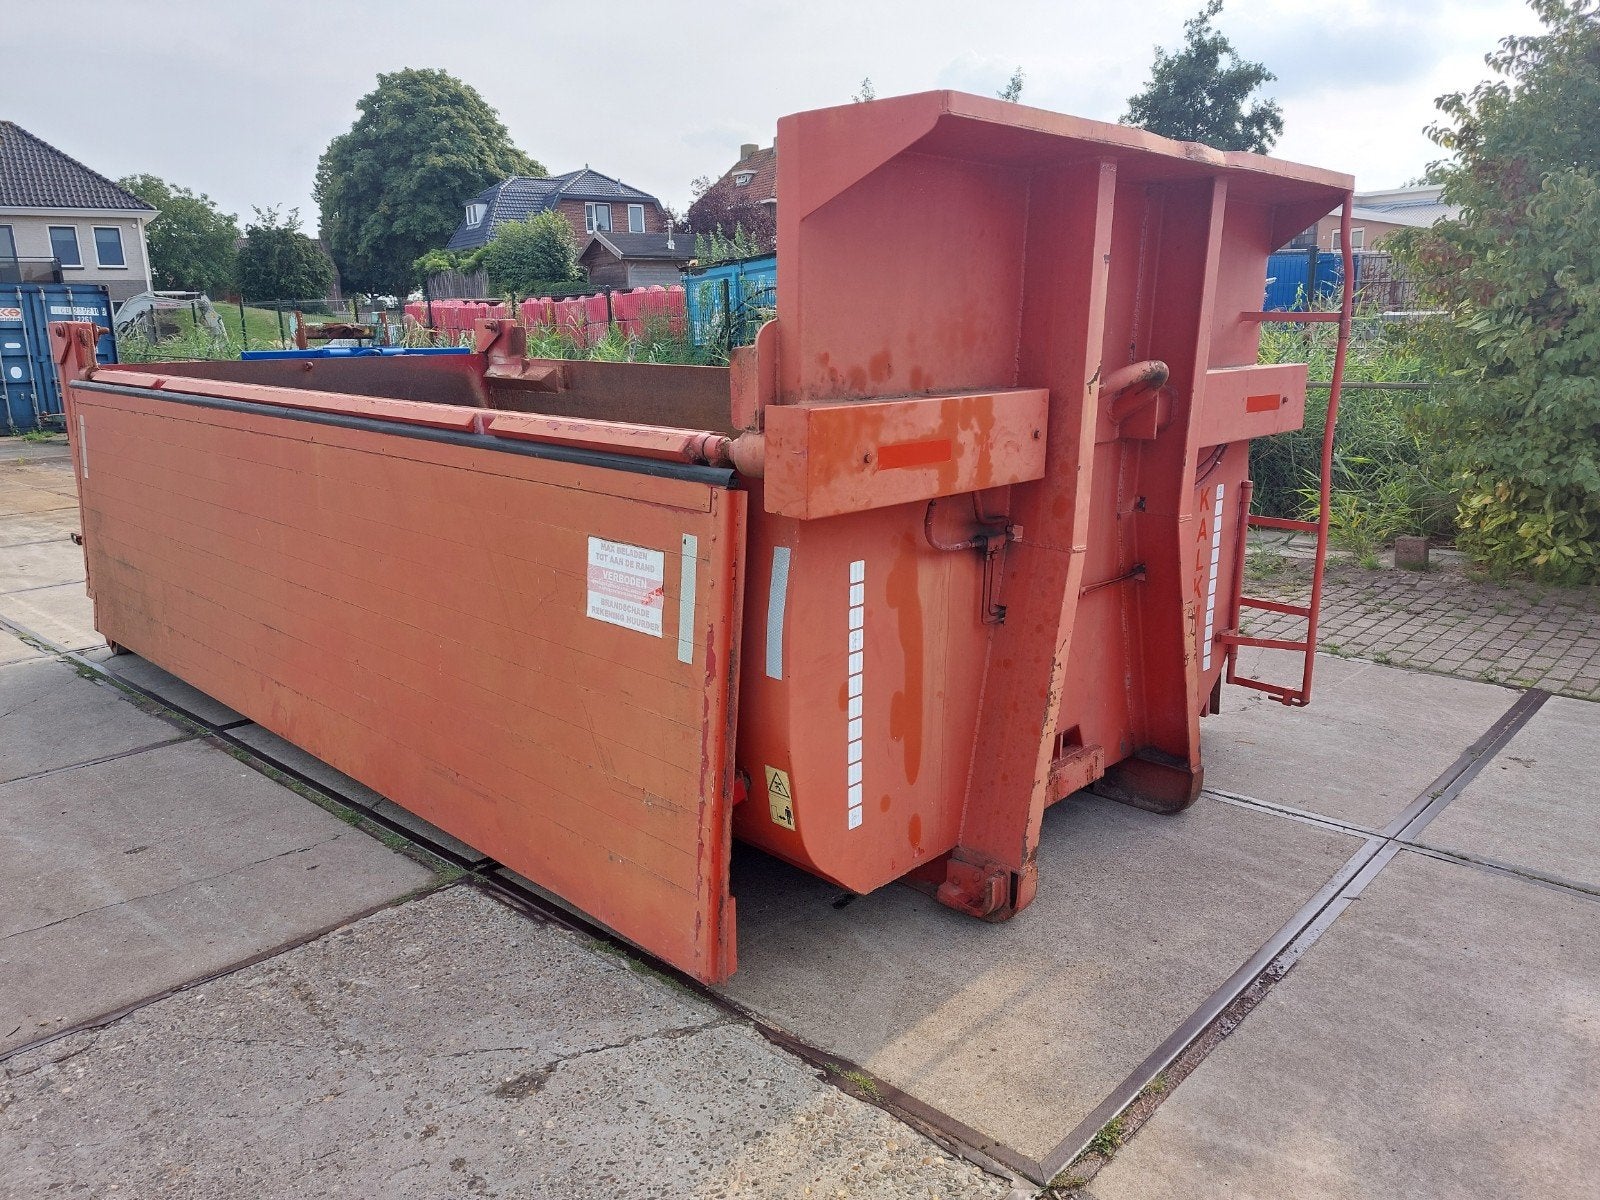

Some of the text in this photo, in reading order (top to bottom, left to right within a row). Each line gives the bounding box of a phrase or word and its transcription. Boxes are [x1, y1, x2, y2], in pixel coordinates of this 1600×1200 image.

[600, 543, 648, 561] MAX BELADEN
[595, 552, 655, 573] TOT AAN DE RAND
[602, 570, 647, 589] VERBODEN
[600, 598, 650, 618] BRANDSCHADE
[591, 606, 660, 632] REKENING HUURDER
